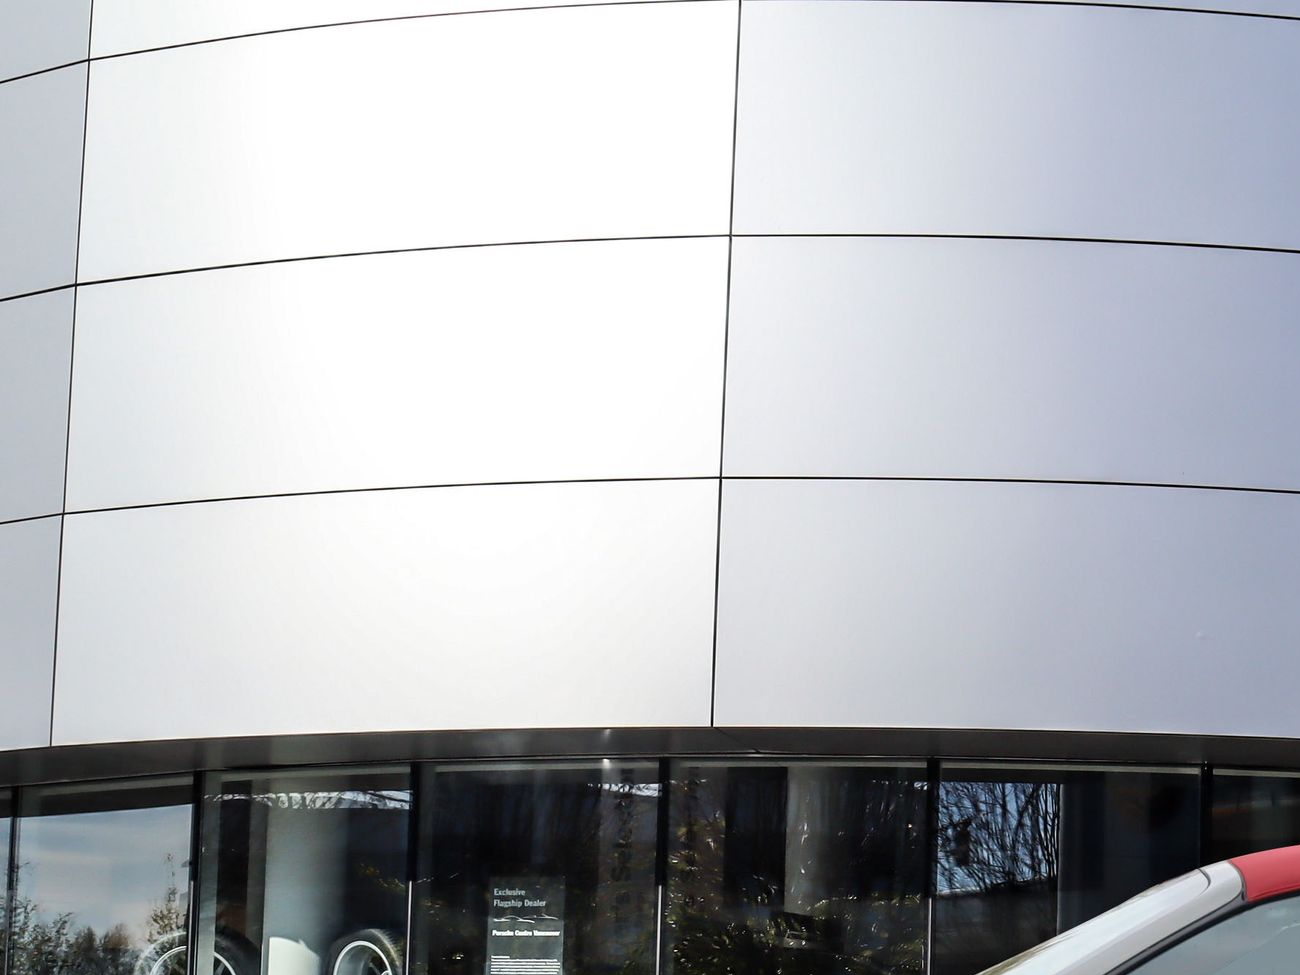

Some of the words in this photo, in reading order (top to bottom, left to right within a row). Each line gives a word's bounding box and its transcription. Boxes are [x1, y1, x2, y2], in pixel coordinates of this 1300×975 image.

[493, 888, 526, 896] Exclusive
[493, 899, 523, 908] Flagship
[524, 899, 547, 907] Dealer
